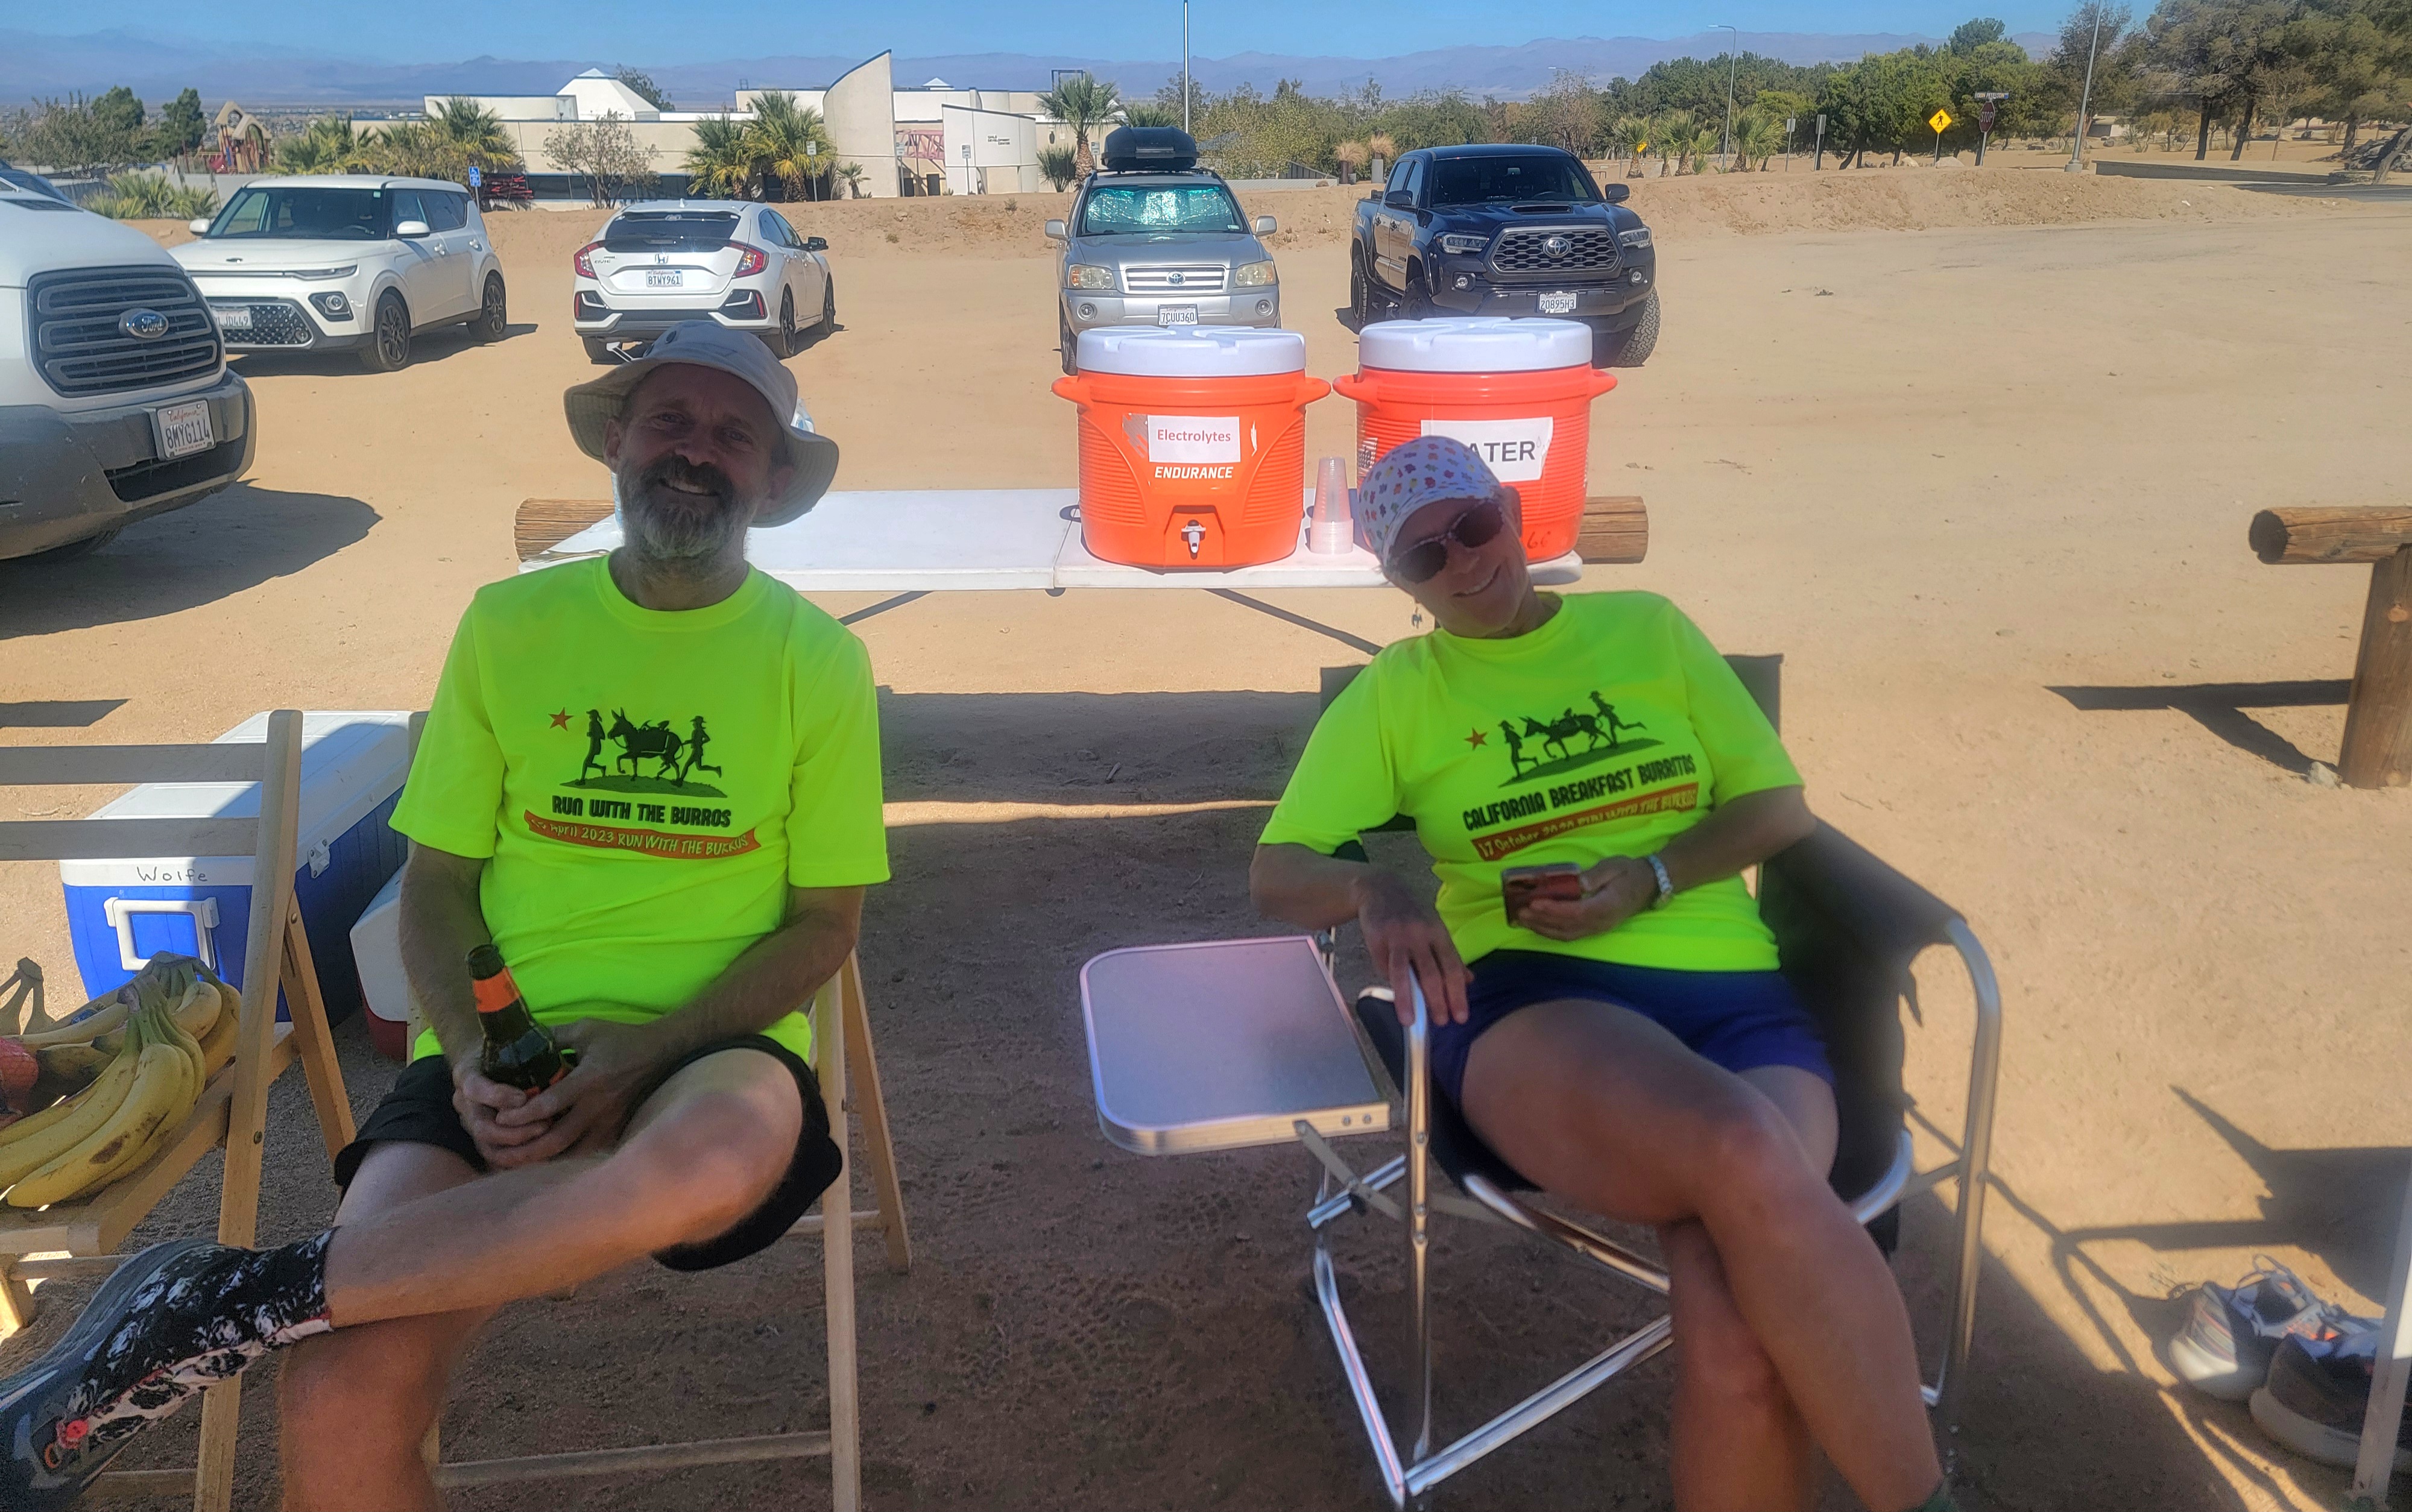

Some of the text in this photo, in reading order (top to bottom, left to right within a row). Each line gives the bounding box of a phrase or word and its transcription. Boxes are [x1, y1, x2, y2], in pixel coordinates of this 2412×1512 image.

[1980, 111, 1994, 123] STOP
[1540, 299, 1574, 309] 20895H3
[141, 315, 163, 333] Ford
[1161, 312, 1195, 323] 7CUU360
[165, 418, 211, 449] 8MYG114
[1157, 429, 1231, 444] Electrolytes
[1469, 441, 1536, 462] ATER
[1154, 466, 1234, 479] ENDURANCE
[1463, 754, 1696, 831] CALIFORNIA BREAKFAST BURRITOS
[552, 795, 731, 828] RUN WITH THE BURROS
[549, 823, 577, 837] April
[581, 827, 614, 843] 2023
[617, 833, 643, 848] RUN
[645, 835, 678, 852] WITH
[681, 840, 704, 855] THE
[1478, 840, 1494, 858] 17
[136, 866, 208, 882] Wolfe
